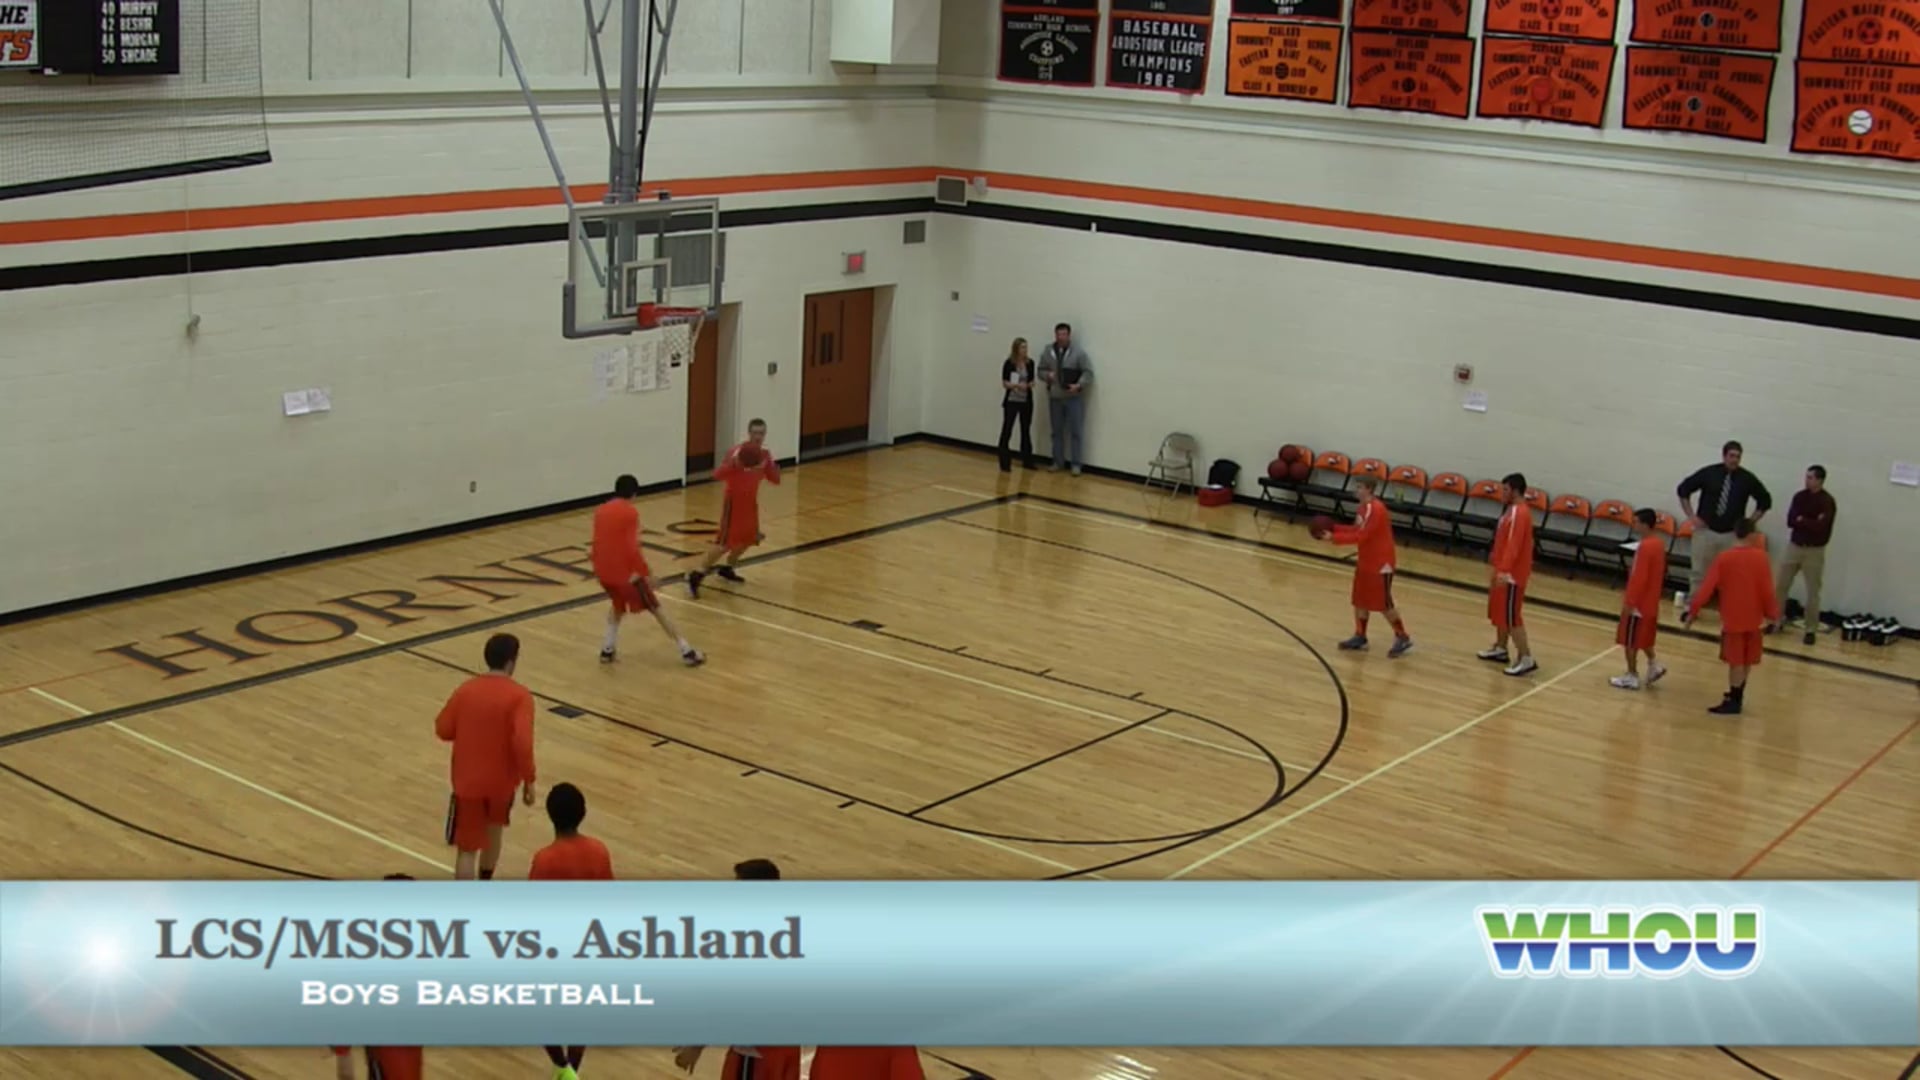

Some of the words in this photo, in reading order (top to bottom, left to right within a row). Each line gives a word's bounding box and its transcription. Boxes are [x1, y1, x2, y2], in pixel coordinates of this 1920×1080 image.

[120, 1, 158, 15] MURPHY
[1123, 20, 1197, 38] BASEBALL
[120, 32, 160, 47] MORGAN
[1112, 36, 1165, 52] AROOSTOOK
[1170, 40, 1206, 56] LEAGUE
[102, 48, 116, 64] 50
[1122, 53, 1192, 73] CHAMPIONS
[1137, 71, 1176, 88] 1982
